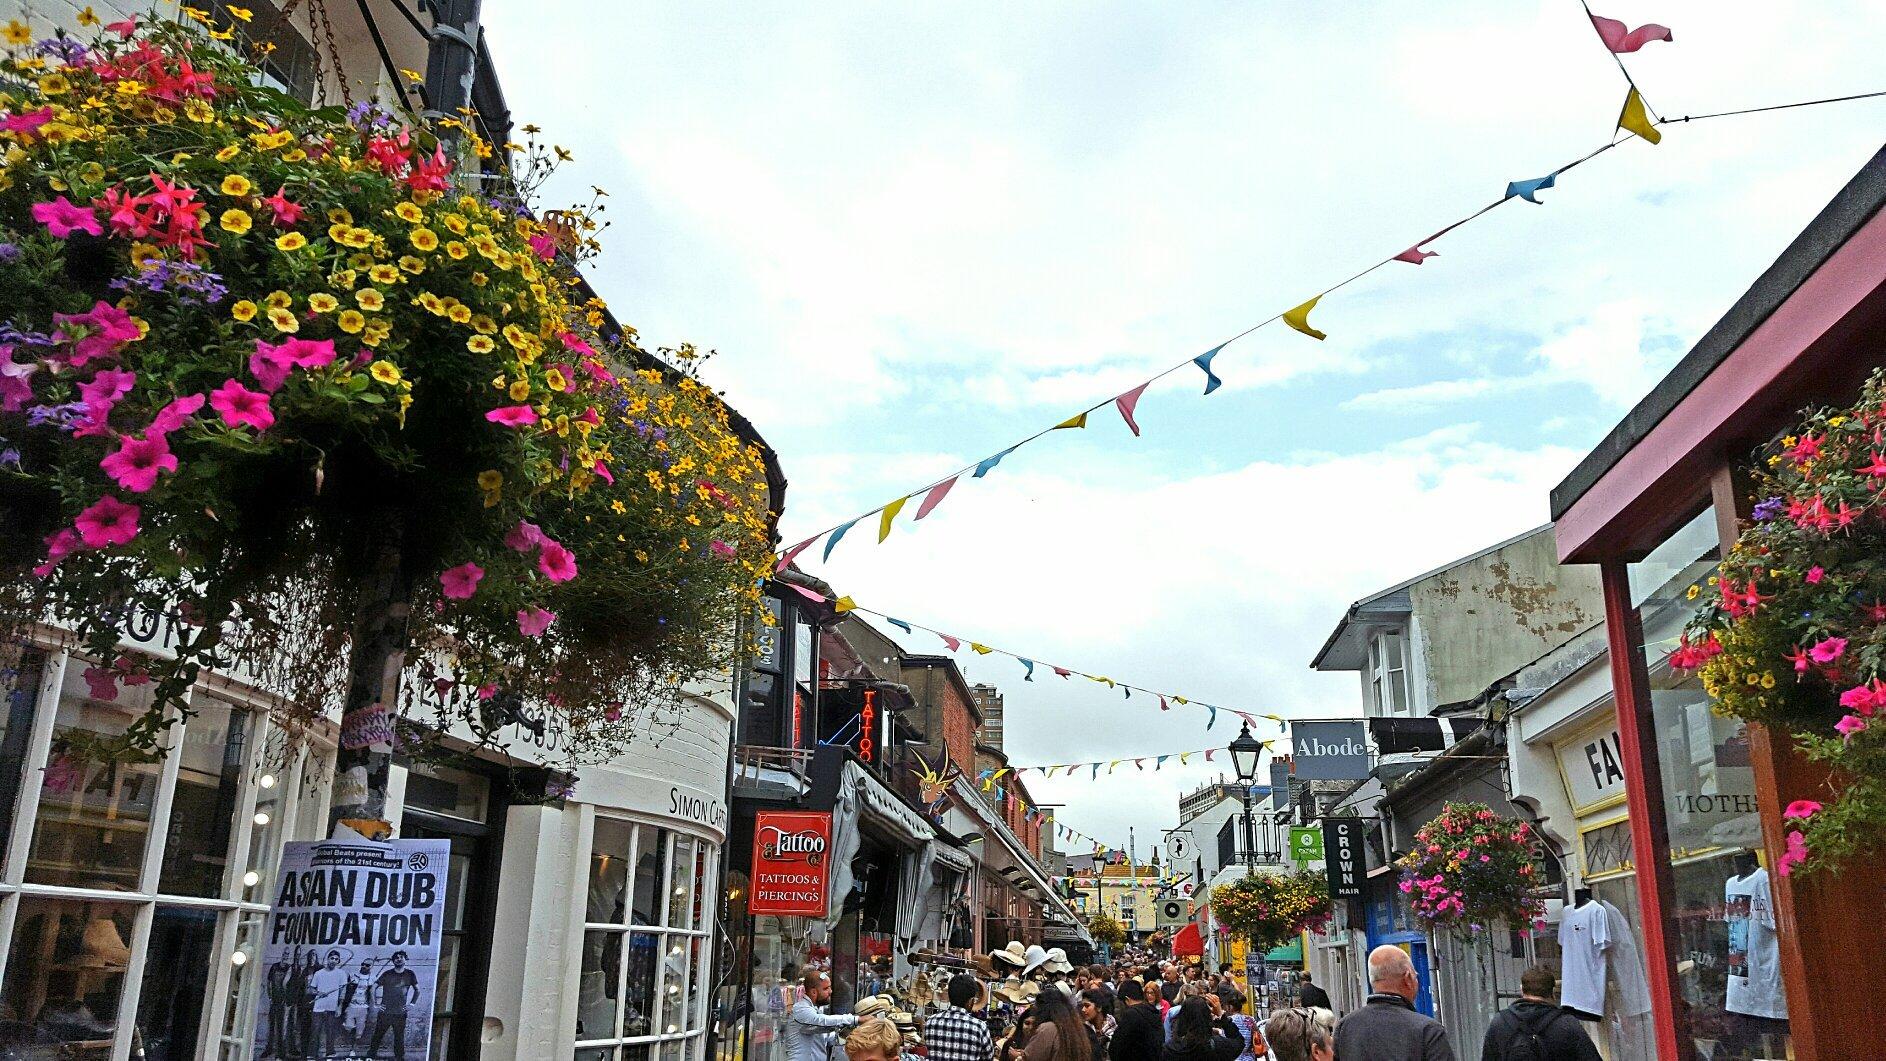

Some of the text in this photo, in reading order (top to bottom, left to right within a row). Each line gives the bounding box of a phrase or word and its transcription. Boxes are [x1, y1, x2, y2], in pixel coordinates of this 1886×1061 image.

[859, 691, 875, 763] TATTOO
[1296, 738, 1365, 756] Abode
[1584, 730, 1625, 790] FA
[669, 787, 708, 822] SIMON
[355, 851, 382, 859] present
[758, 825, 825, 856] Tattoo
[1337, 824, 1354, 884] CROWN
[278, 869, 436, 909] ASIAN DUB
[758, 891, 819, 901] PIERCINGS
[760, 873, 819, 884] TATTOOS &
[272, 911, 433, 946] FOUNDATION
